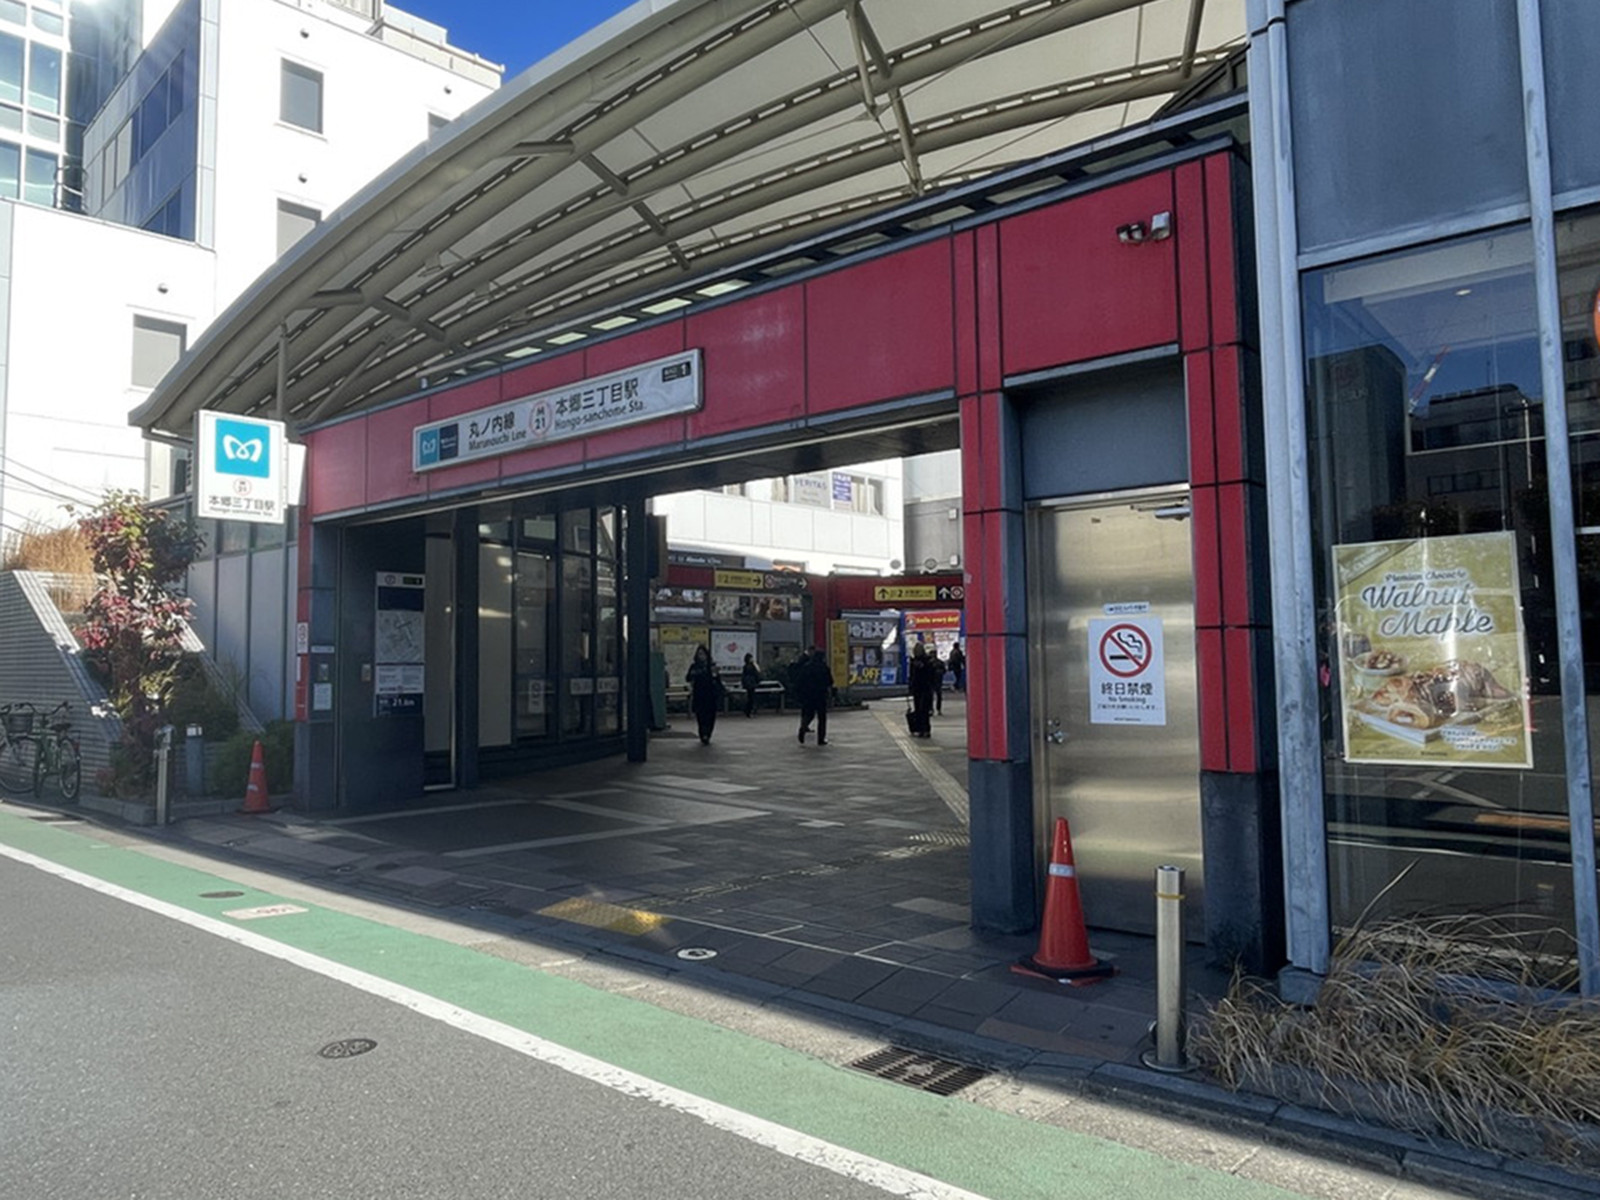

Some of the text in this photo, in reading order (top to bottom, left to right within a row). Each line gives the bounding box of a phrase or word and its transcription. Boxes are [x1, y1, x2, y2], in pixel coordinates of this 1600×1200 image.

[555, 377, 639, 416] 本郷三丁目駅
[536, 406, 545, 415] M
[554, 400, 647, 431] Hongo-sanchome Sta.
[469, 411, 515, 439] 丸ノ内線
[535, 417, 546, 430] 21
[469, 432, 510, 451] Marunouchi
[511, 429, 527, 442] Line
[794, 477, 828, 490] VERITAS
[208, 495, 275, 510] 本郷三丁目駅
[1362, 582, 1475, 610] Walnut
[1381, 608, 1493, 641] Maple
[1101, 682, 1153, 696] 終日禁煙
